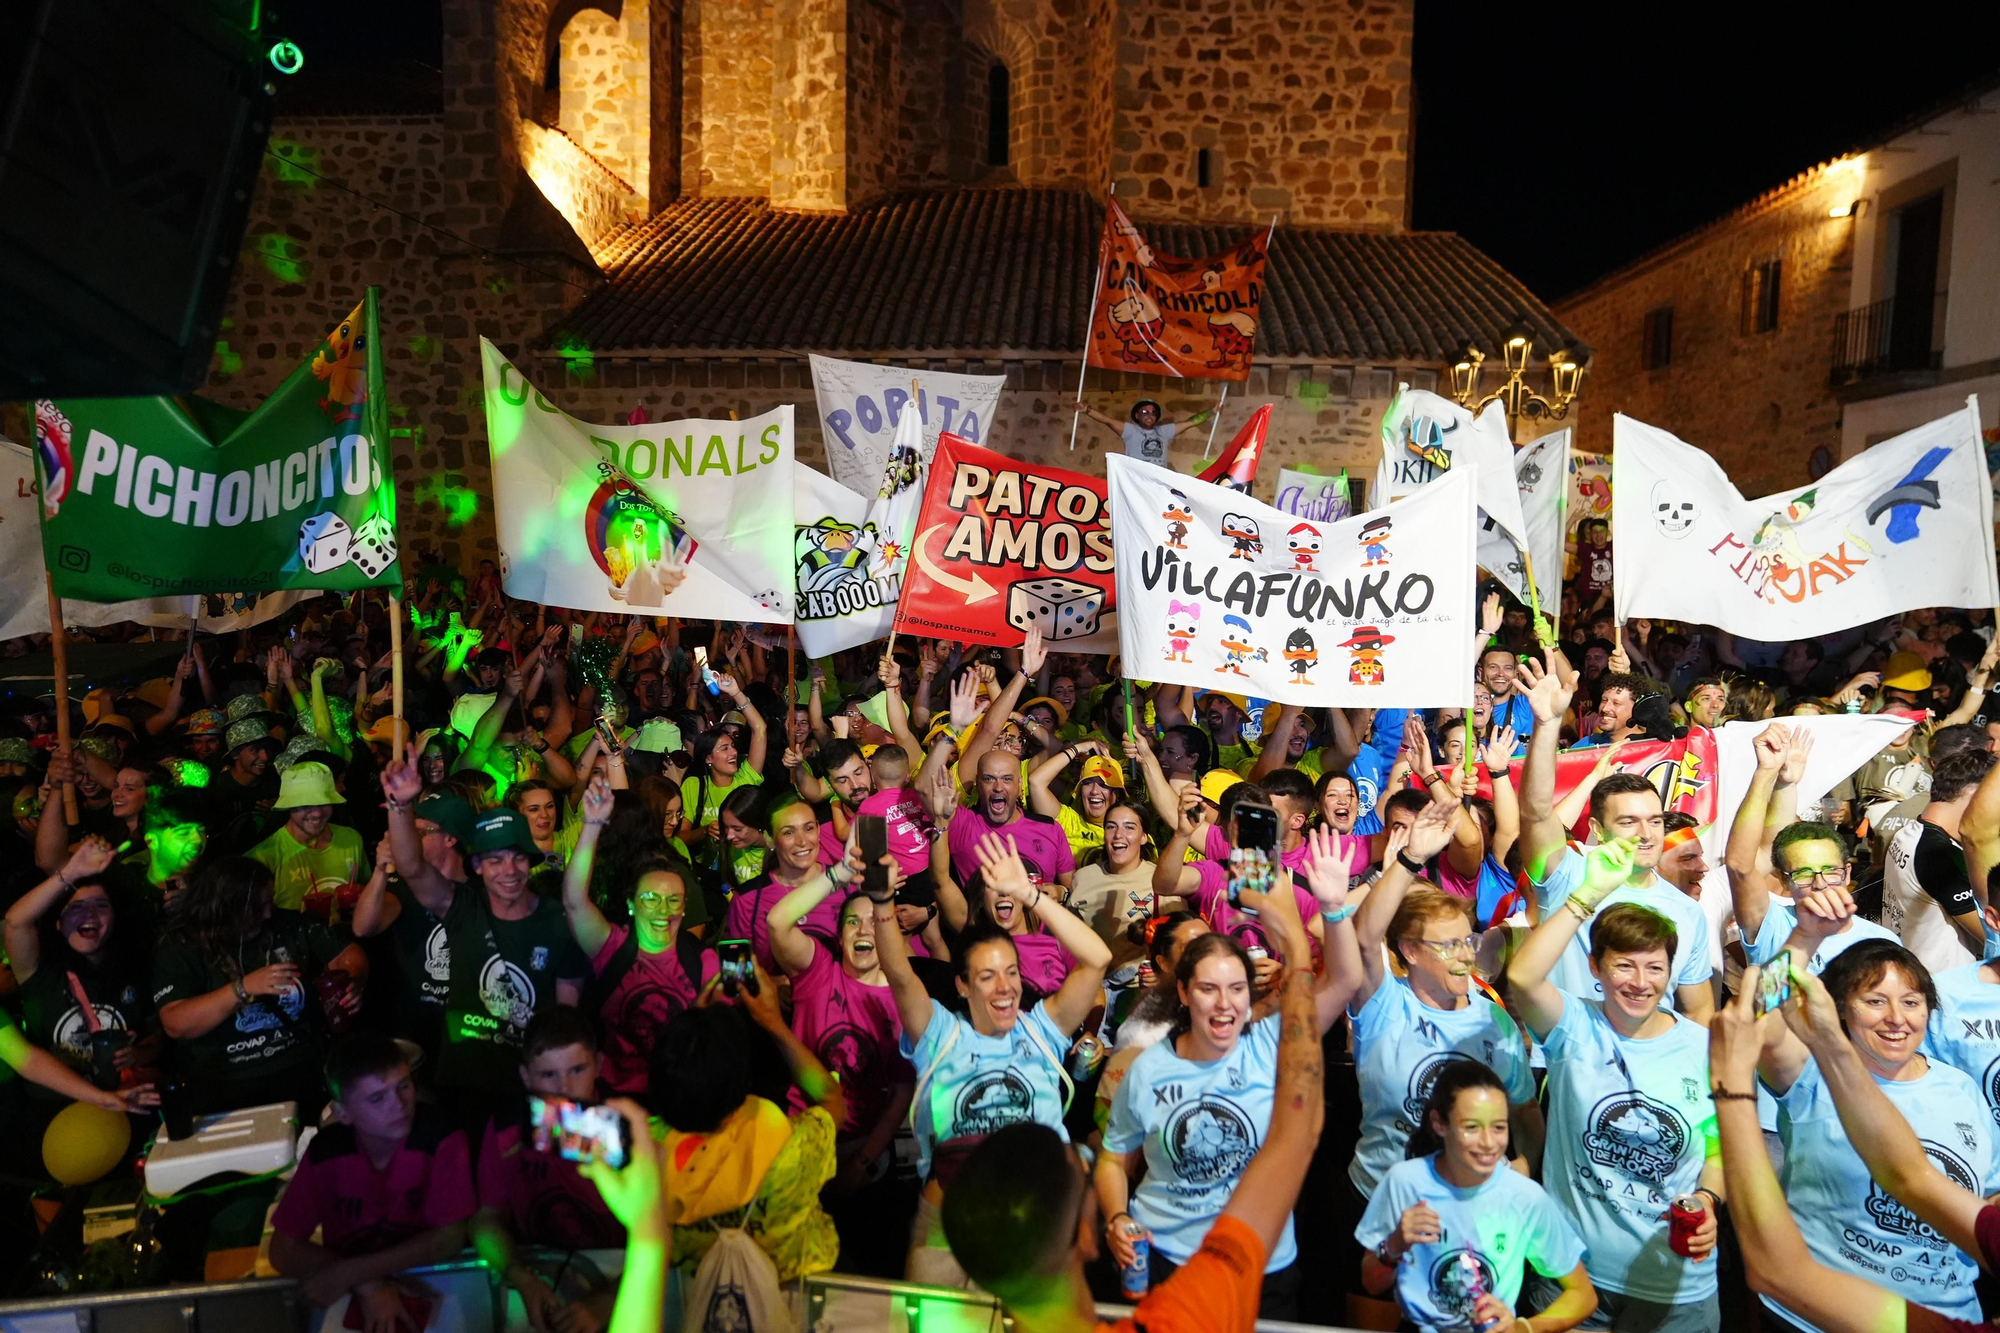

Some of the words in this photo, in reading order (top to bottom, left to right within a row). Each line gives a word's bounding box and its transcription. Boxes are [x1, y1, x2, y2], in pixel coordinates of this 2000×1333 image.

[1107, 258, 1260, 314] CAVRNICOLA
[944, 514, 1115, 573] AMOS
[908, 615, 997, 638] @lospatosamos
[1152, 1084, 1184, 1107] XII
[1588, 1135, 1629, 1157] GRAN
[1884, 1216, 1900, 1227] DE
[1843, 1228, 1903, 1258] COVAP
